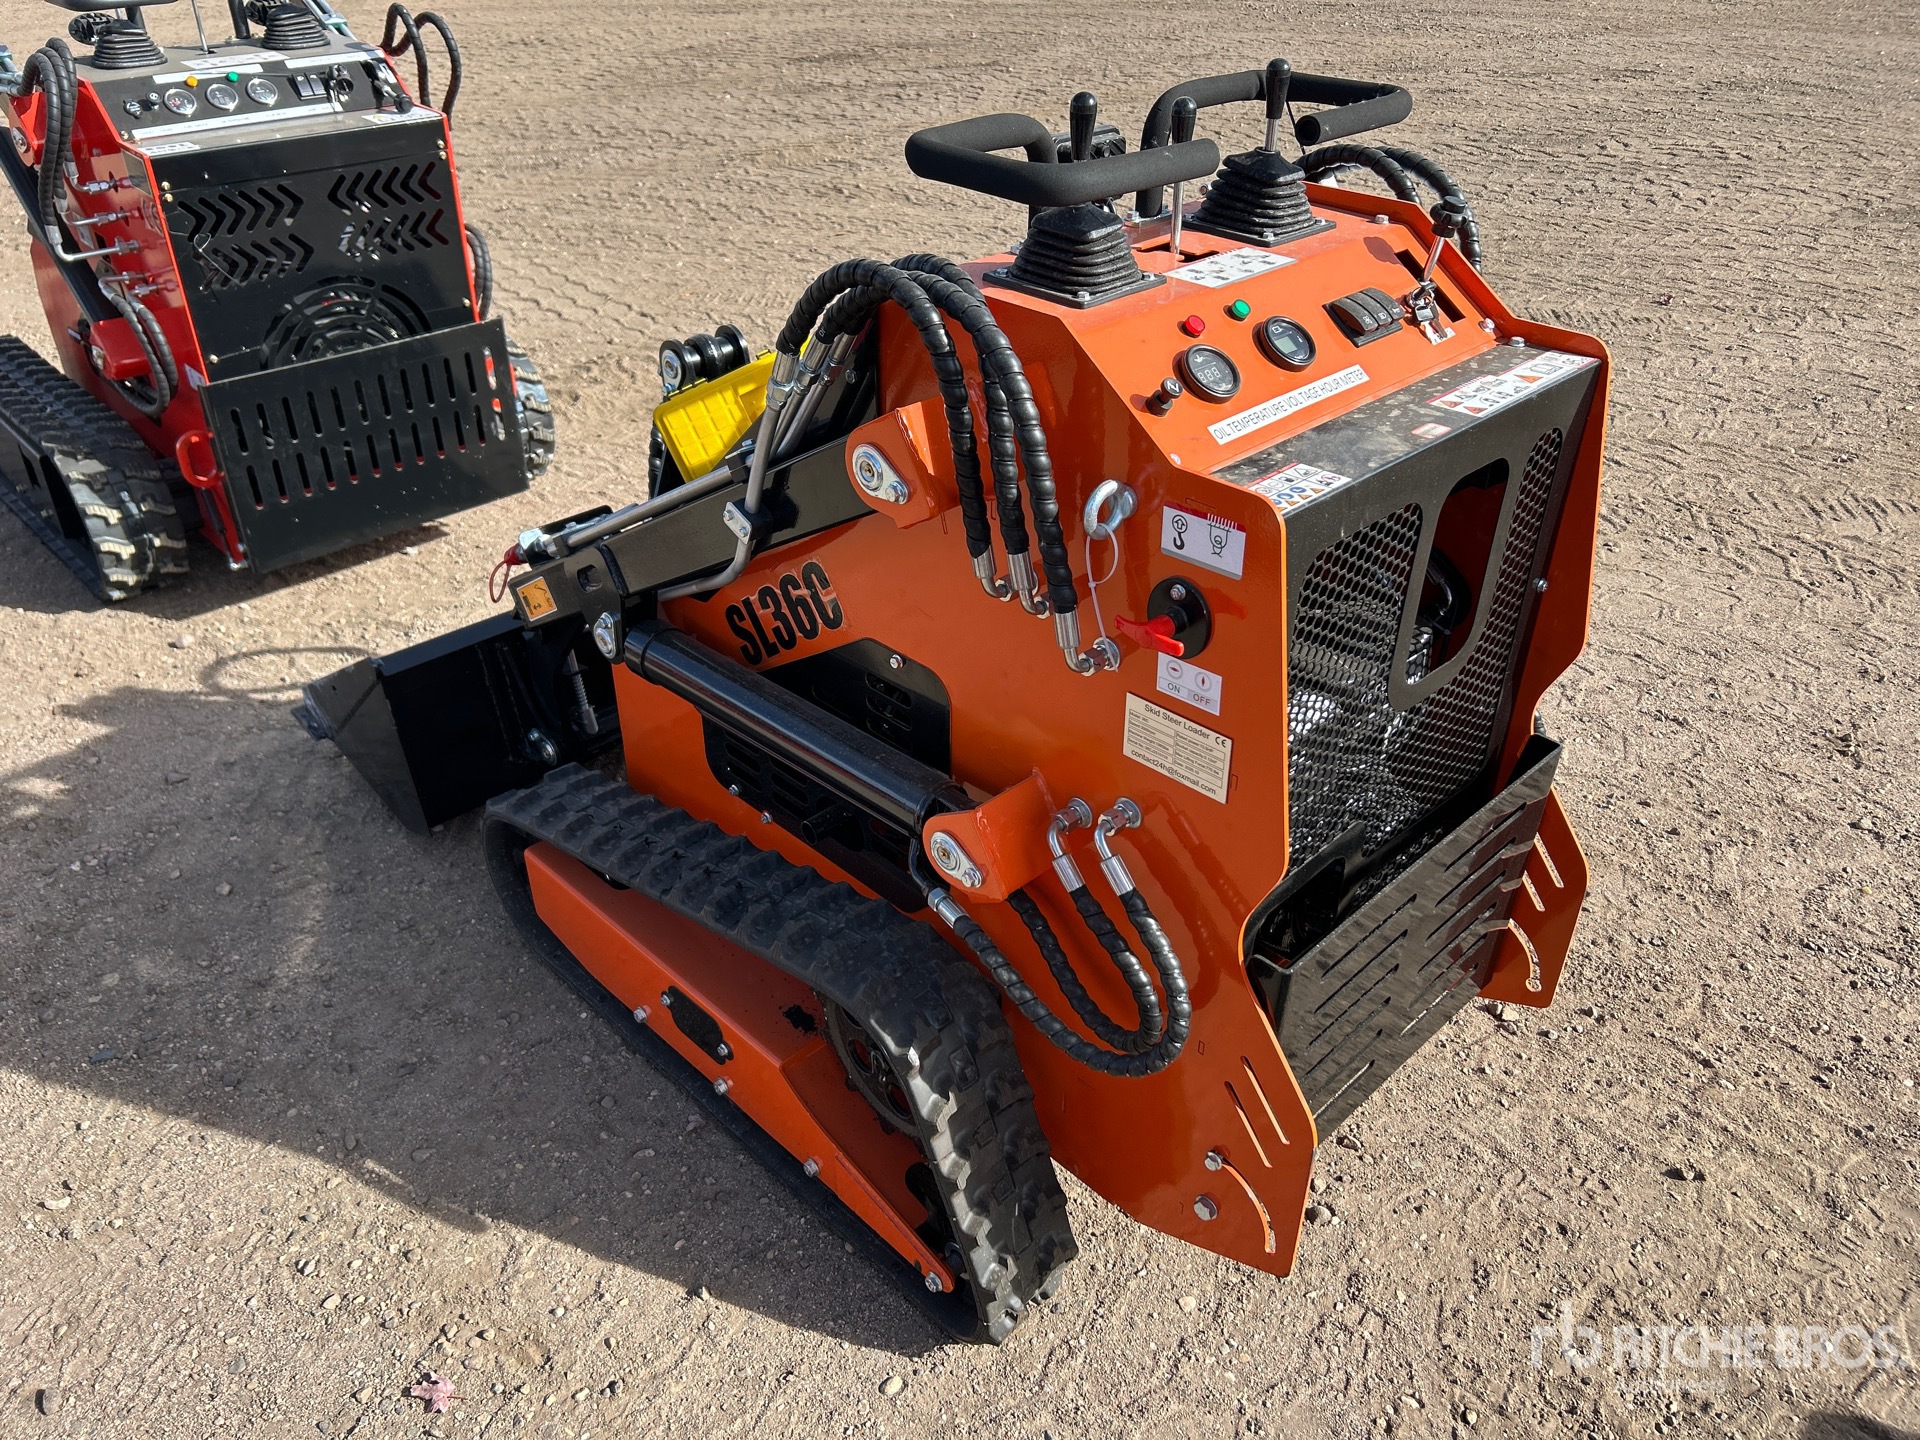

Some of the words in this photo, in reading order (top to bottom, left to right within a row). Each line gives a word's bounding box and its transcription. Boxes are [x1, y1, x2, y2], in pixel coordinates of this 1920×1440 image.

[1213, 425, 1231, 440] OIL
[1226, 401, 1287, 435] TEMPERATURE
[1283, 386, 1321, 411] VOLTAGE
[1319, 378, 1345, 395] HOUR
[1340, 368, 1366, 387] METER
[725, 561, 843, 665] SL36C
[1167, 682, 1181, 693] ON
[1193, 693, 1211, 705] OFF
[1144, 703, 1160, 717] Skid
[1162, 712, 1182, 726] Steer
[1183, 721, 1210, 740] Loader
[1215, 736, 1227, 748] CE
[1131, 749, 1217, 795] contact24h@foxmail.com
